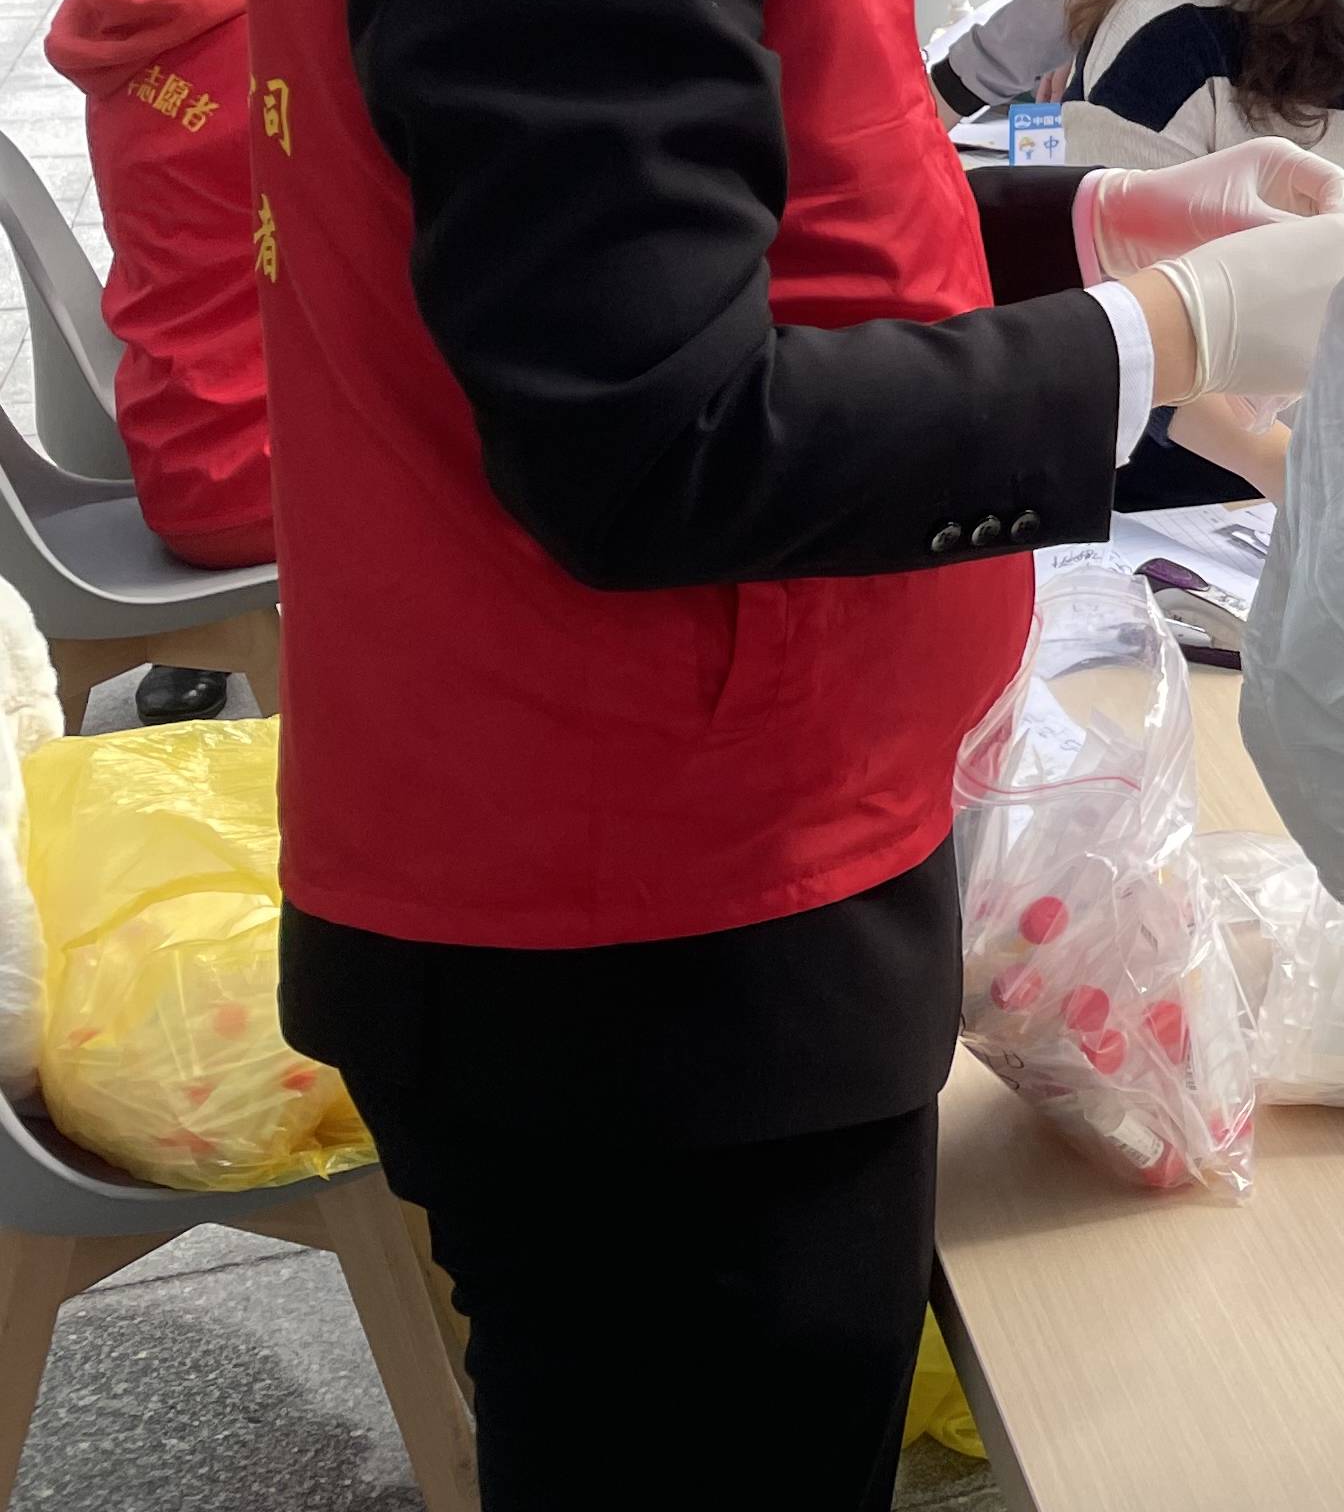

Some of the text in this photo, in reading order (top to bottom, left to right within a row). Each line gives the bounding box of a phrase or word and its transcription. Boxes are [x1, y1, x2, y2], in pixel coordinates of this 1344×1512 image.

[128, 65, 220, 133] 志愿者
[1043, 135, 1060, 161] 中
